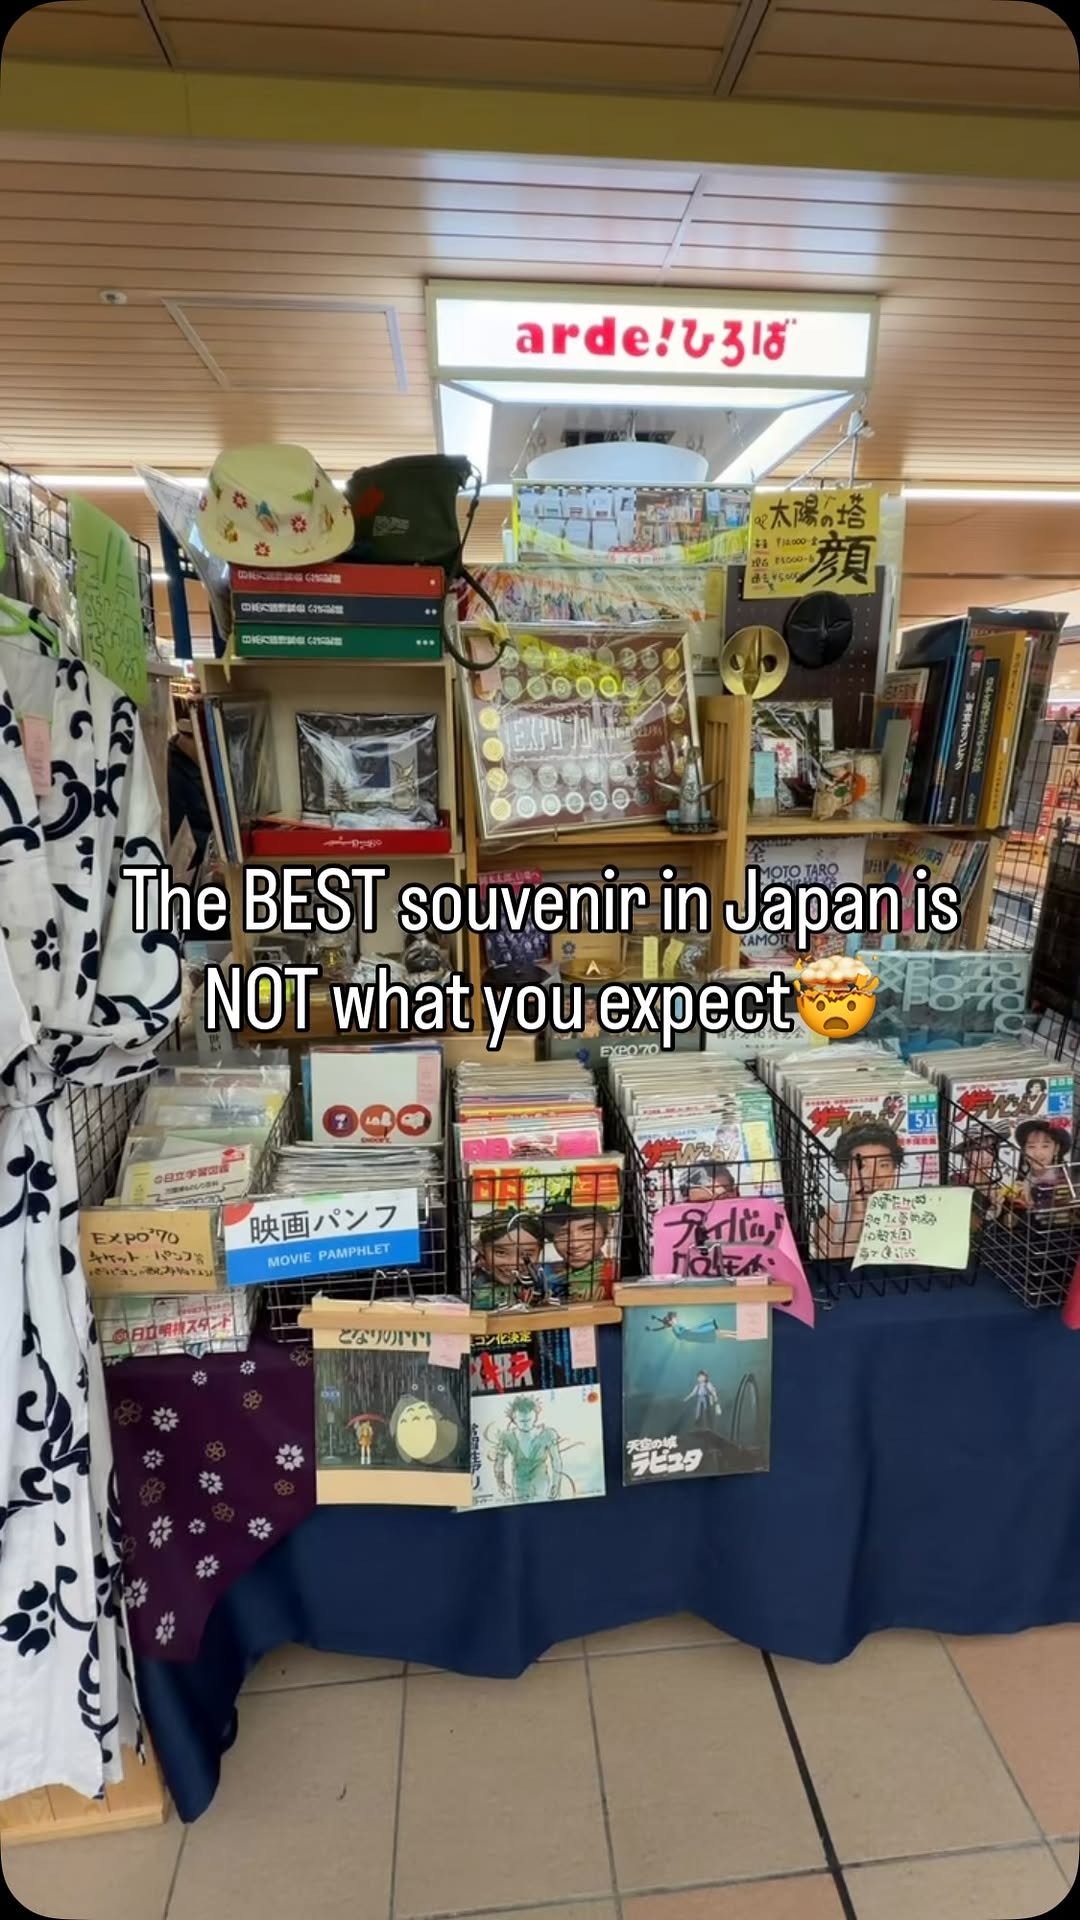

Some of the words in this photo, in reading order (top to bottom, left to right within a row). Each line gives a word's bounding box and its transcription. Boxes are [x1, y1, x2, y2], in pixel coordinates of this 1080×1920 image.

[516, 313, 797, 368] arde!ひろば
[769, 493, 866, 529] 太陽の塔
[796, 530, 877, 587] 顔
[760, 864, 801, 880] MOTO
[805, 863, 839, 878] TARO
[249, 1204, 397, 1244] 映画パンフ
[267, 1252, 312, 1268] MOVIE
[318, 1243, 391, 1261] PAMPHLET
[338, 1328, 432, 1347] となりのトト
[630, 1448, 704, 1477] ラピュタ
